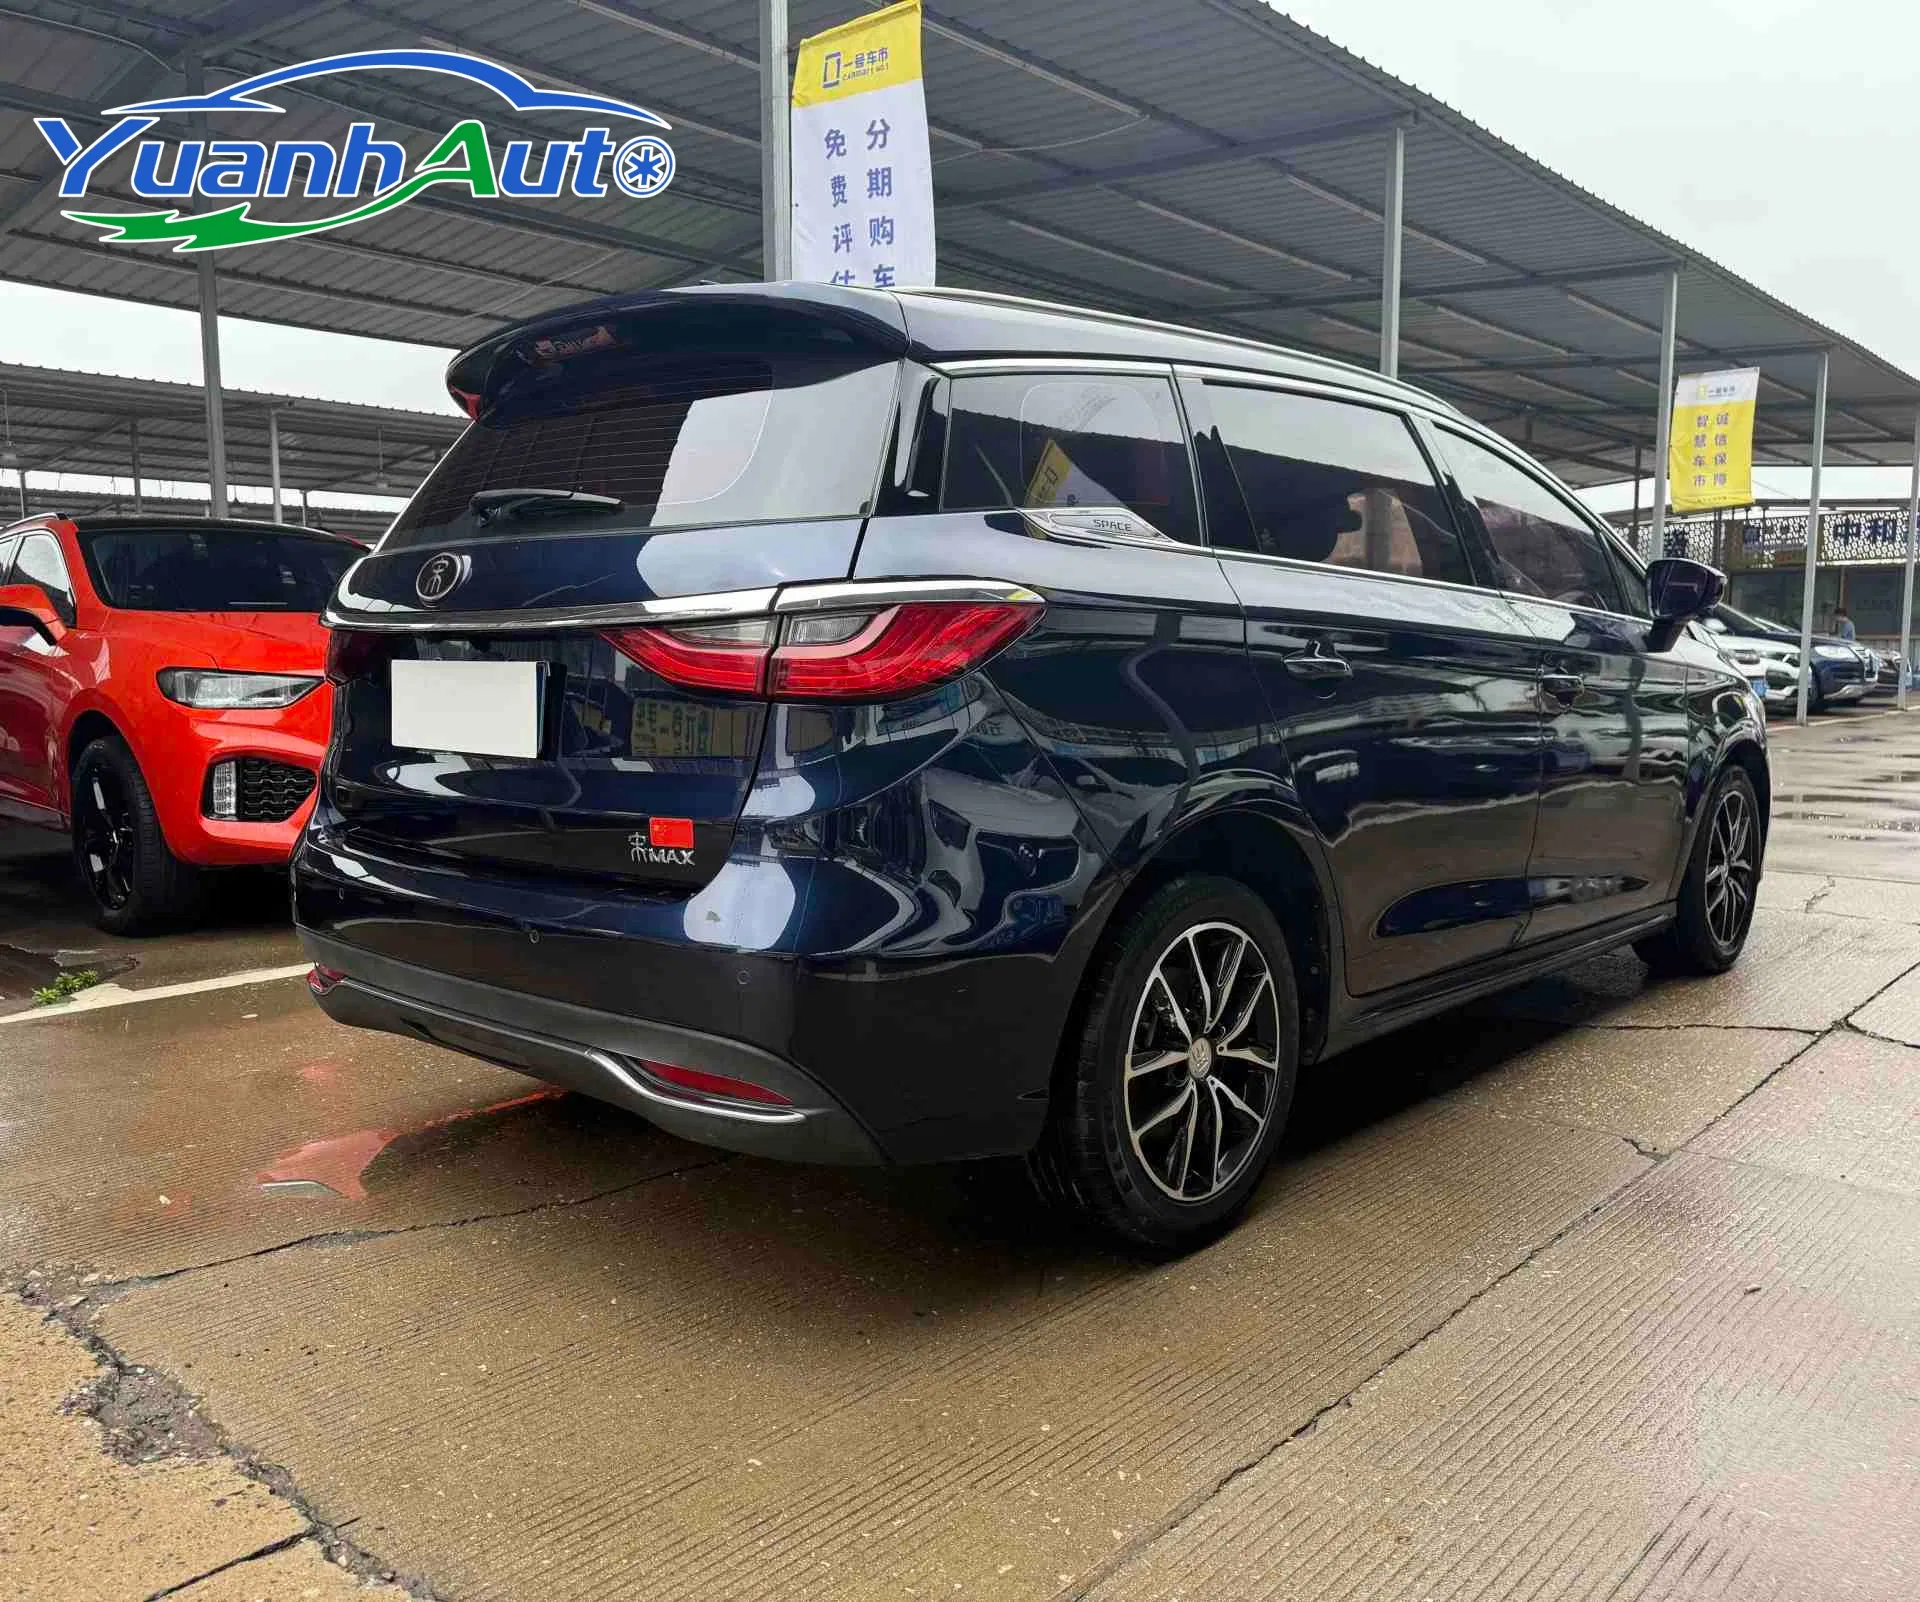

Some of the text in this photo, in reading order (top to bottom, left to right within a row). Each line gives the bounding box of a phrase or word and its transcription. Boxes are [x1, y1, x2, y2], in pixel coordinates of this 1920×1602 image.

[843, 47, 889, 69] 一号车市
[866, 118, 896, 288] 分期购车
[1093, 518, 1132, 533] SPACE
